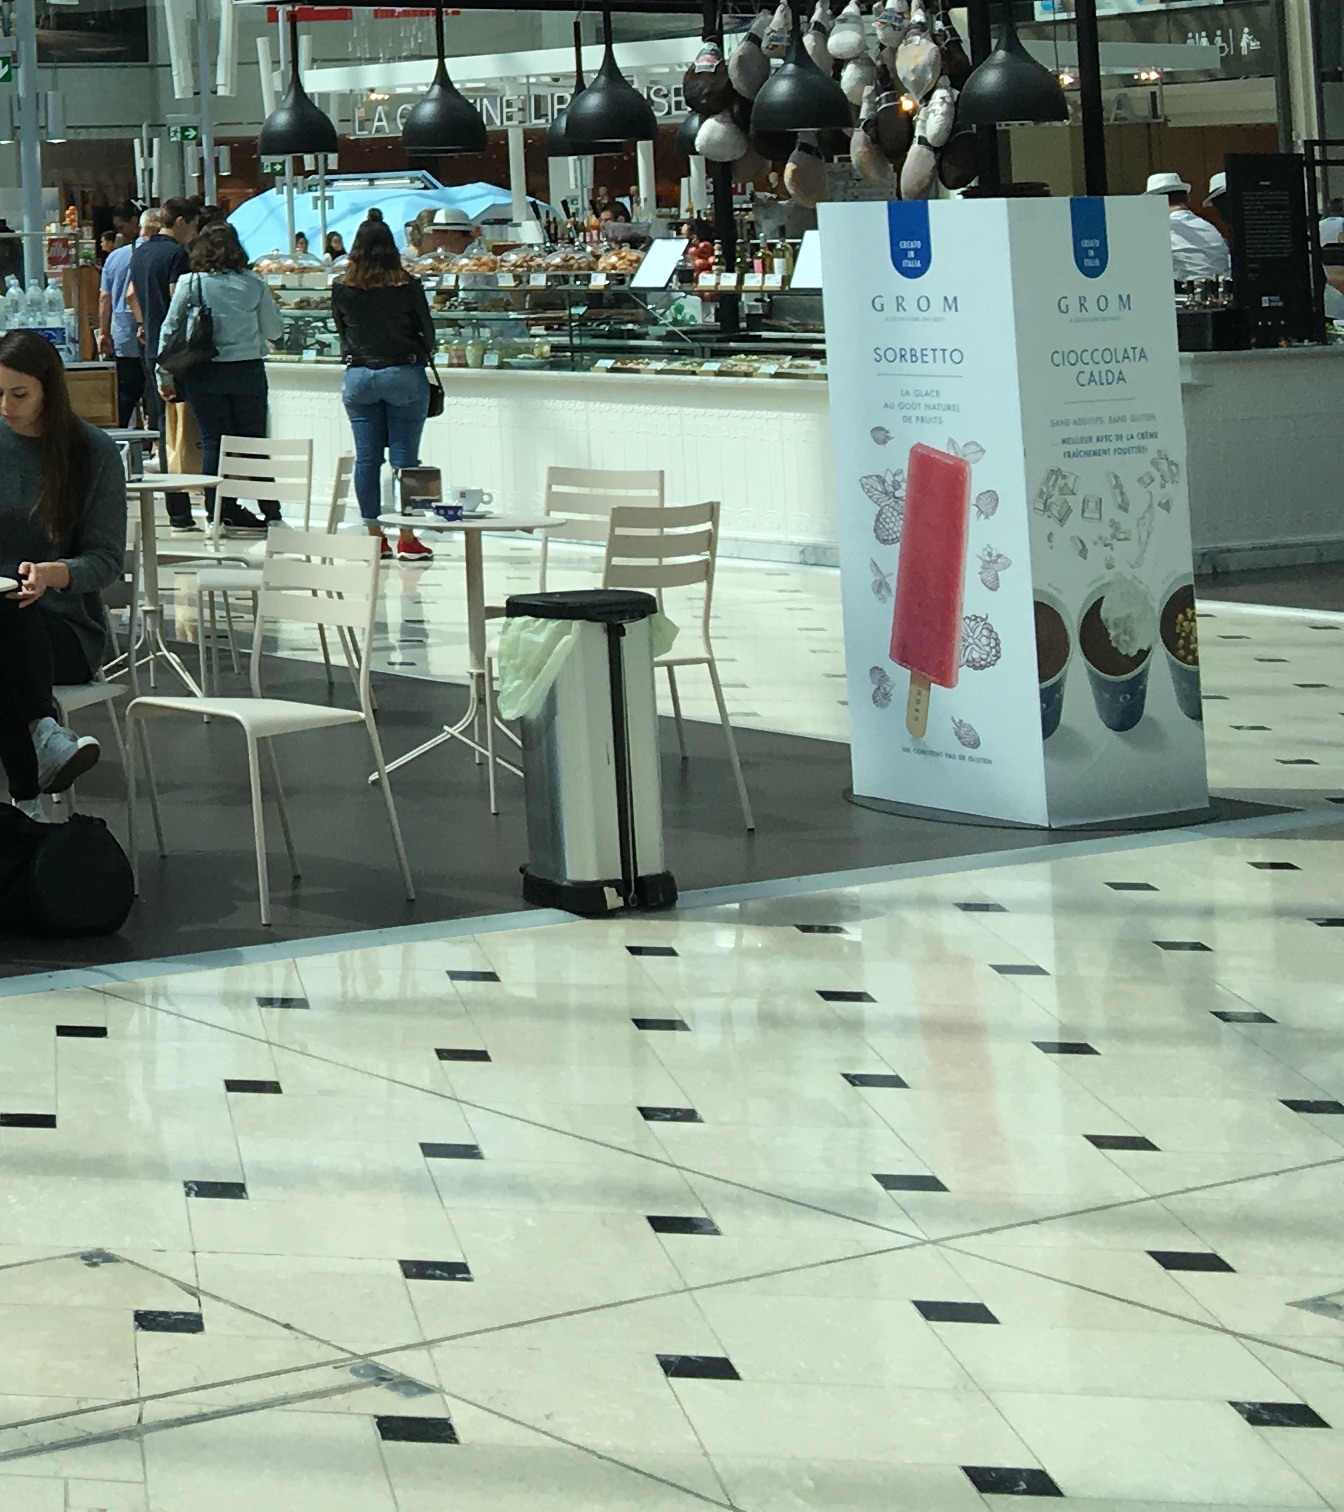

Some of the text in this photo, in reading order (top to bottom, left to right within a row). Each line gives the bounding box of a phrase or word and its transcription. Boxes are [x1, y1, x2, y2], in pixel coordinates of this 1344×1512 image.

[355, 106, 390, 136] LA
[871, 295, 959, 313] GROM
[1057, 293, 1132, 314] GROM
[873, 347, 964, 365] SORBETTO
[1050, 346, 1149, 368] CIOCCOLATA
[1076, 368, 1127, 387] CALDA
[900, 389, 941, 398] LA GLACE
[883, 401, 896, 410] AU
[902, 415, 944, 425] DE FRUITS
[1095, 434, 1113, 443] AVEC
